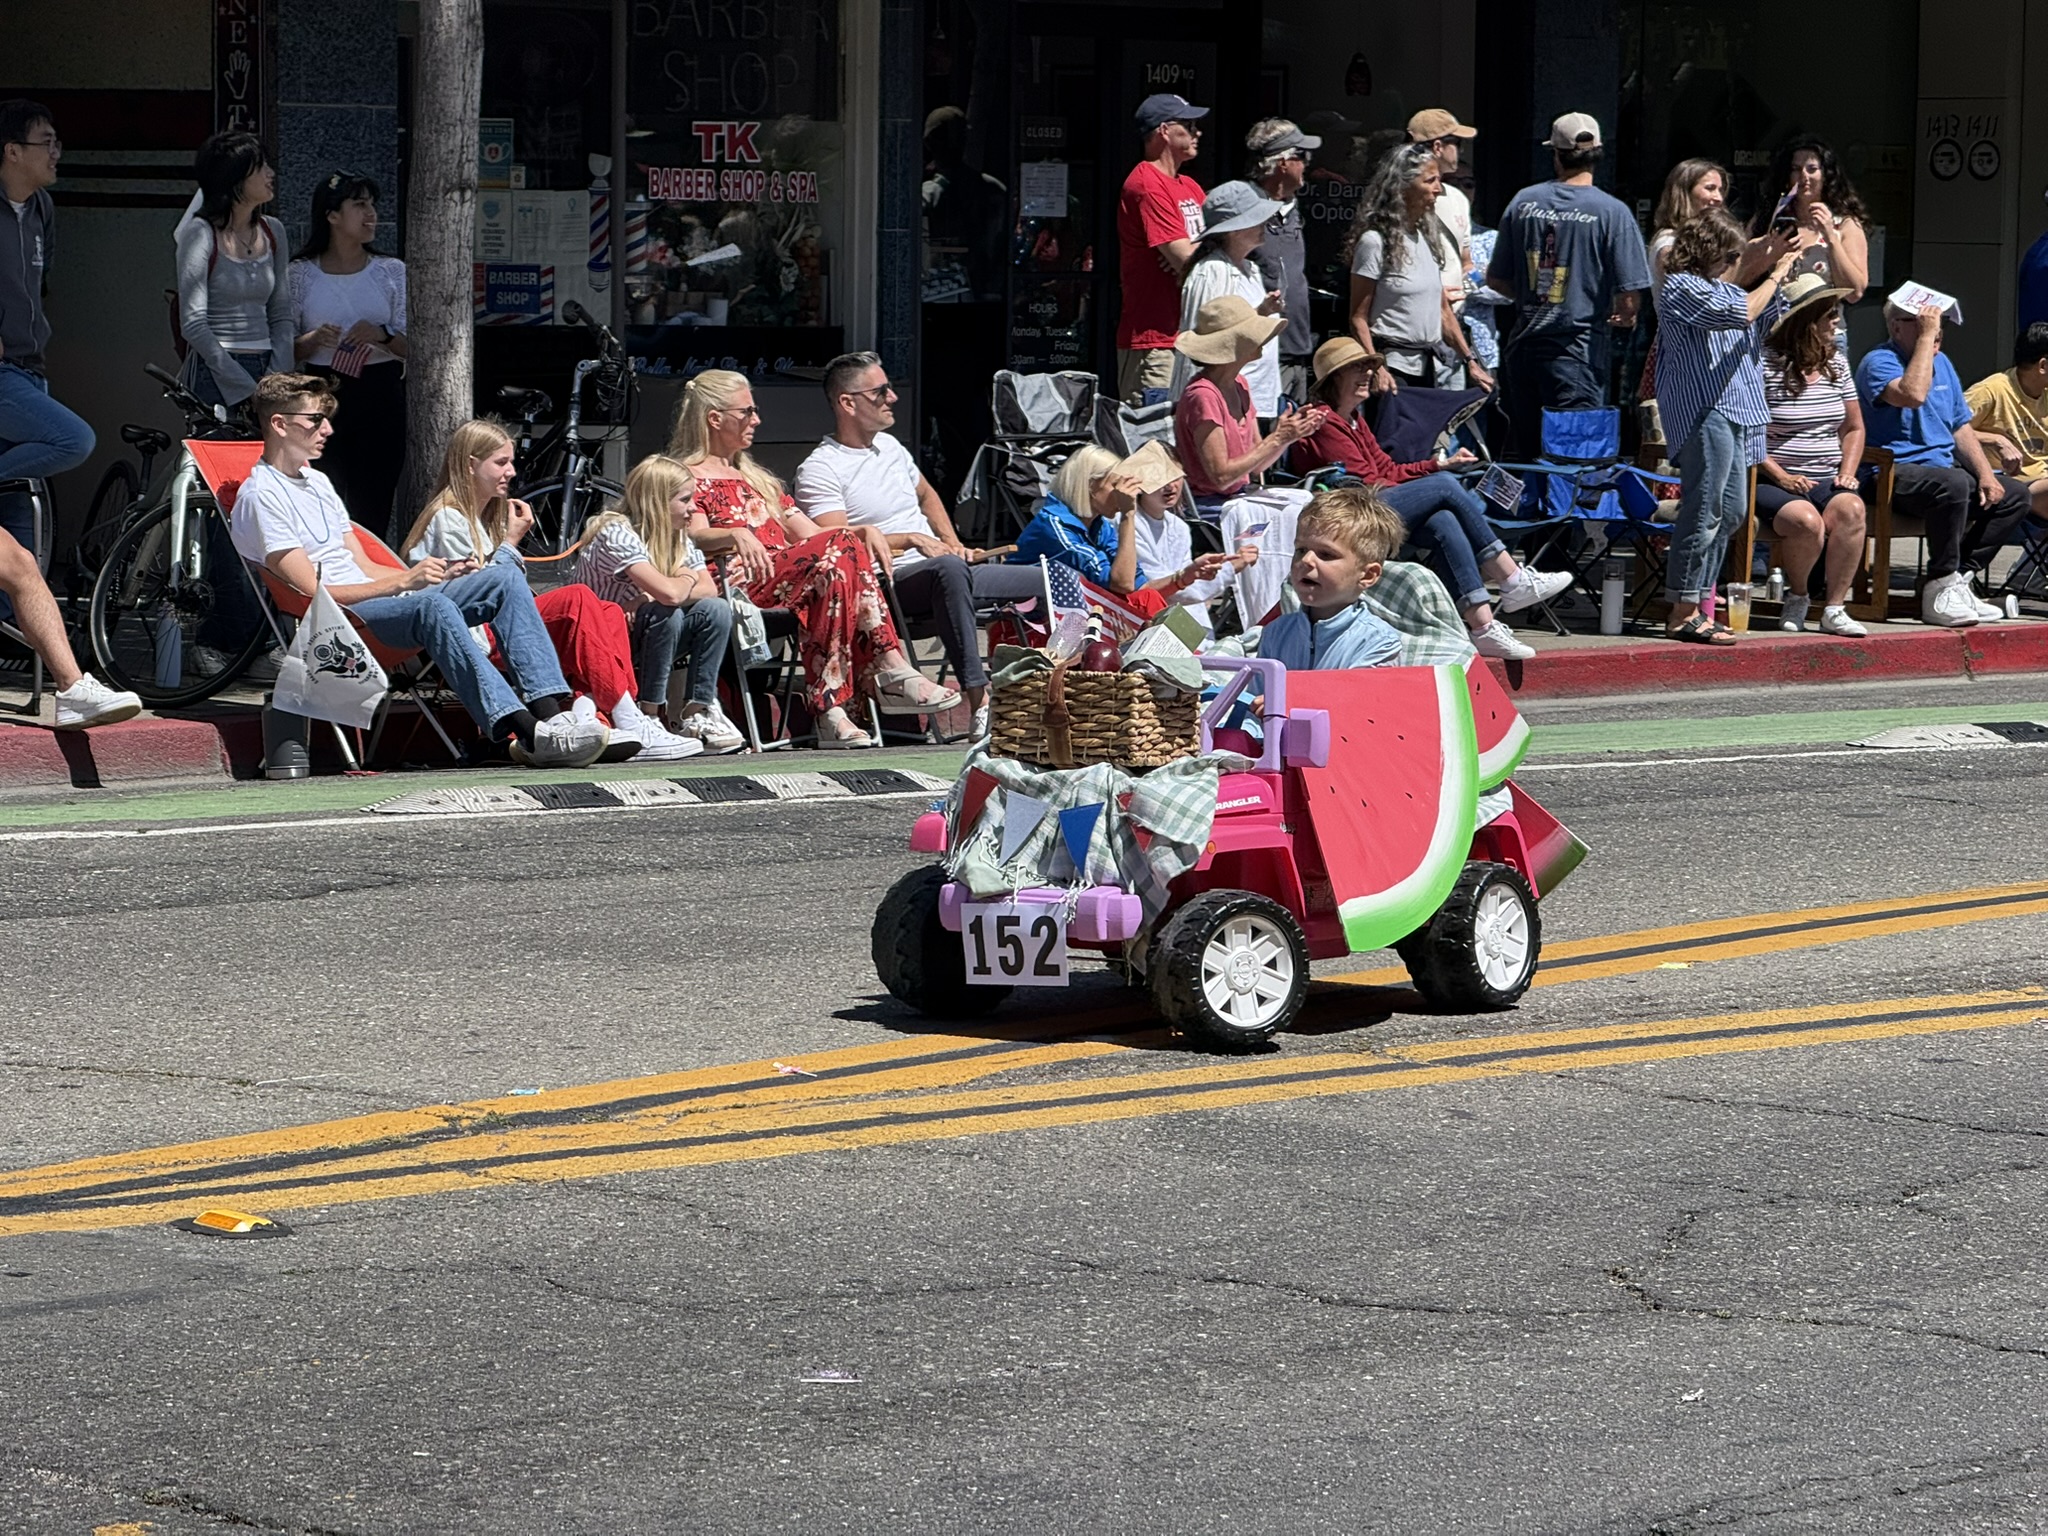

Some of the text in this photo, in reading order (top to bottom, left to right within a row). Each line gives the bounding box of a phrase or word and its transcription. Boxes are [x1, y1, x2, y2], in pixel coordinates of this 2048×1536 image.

[663, 49, 800, 115] SHOP
[1146, 64, 1180, 83] 1409
[1026, 127, 1063, 138] CLOSED
[1926, 114, 1999, 138] 1413 1411
[692, 121, 762, 164] TK
[648, 167, 819, 204] BARBER SHOP & SPA
[1328, 181, 1364, 198] Dan
[1311, 202, 1354, 224] Opto
[1518, 201, 1598, 223] Budweiser
[489, 271, 539, 286] BARBER
[496, 291, 530, 305] SHOP
[1029, 303, 1059, 314] HOURS
[1010, 355, 1036, 365] :30am
[1215, 795, 1262, 811] RANGLER
[968, 915, 1061, 976] 152
